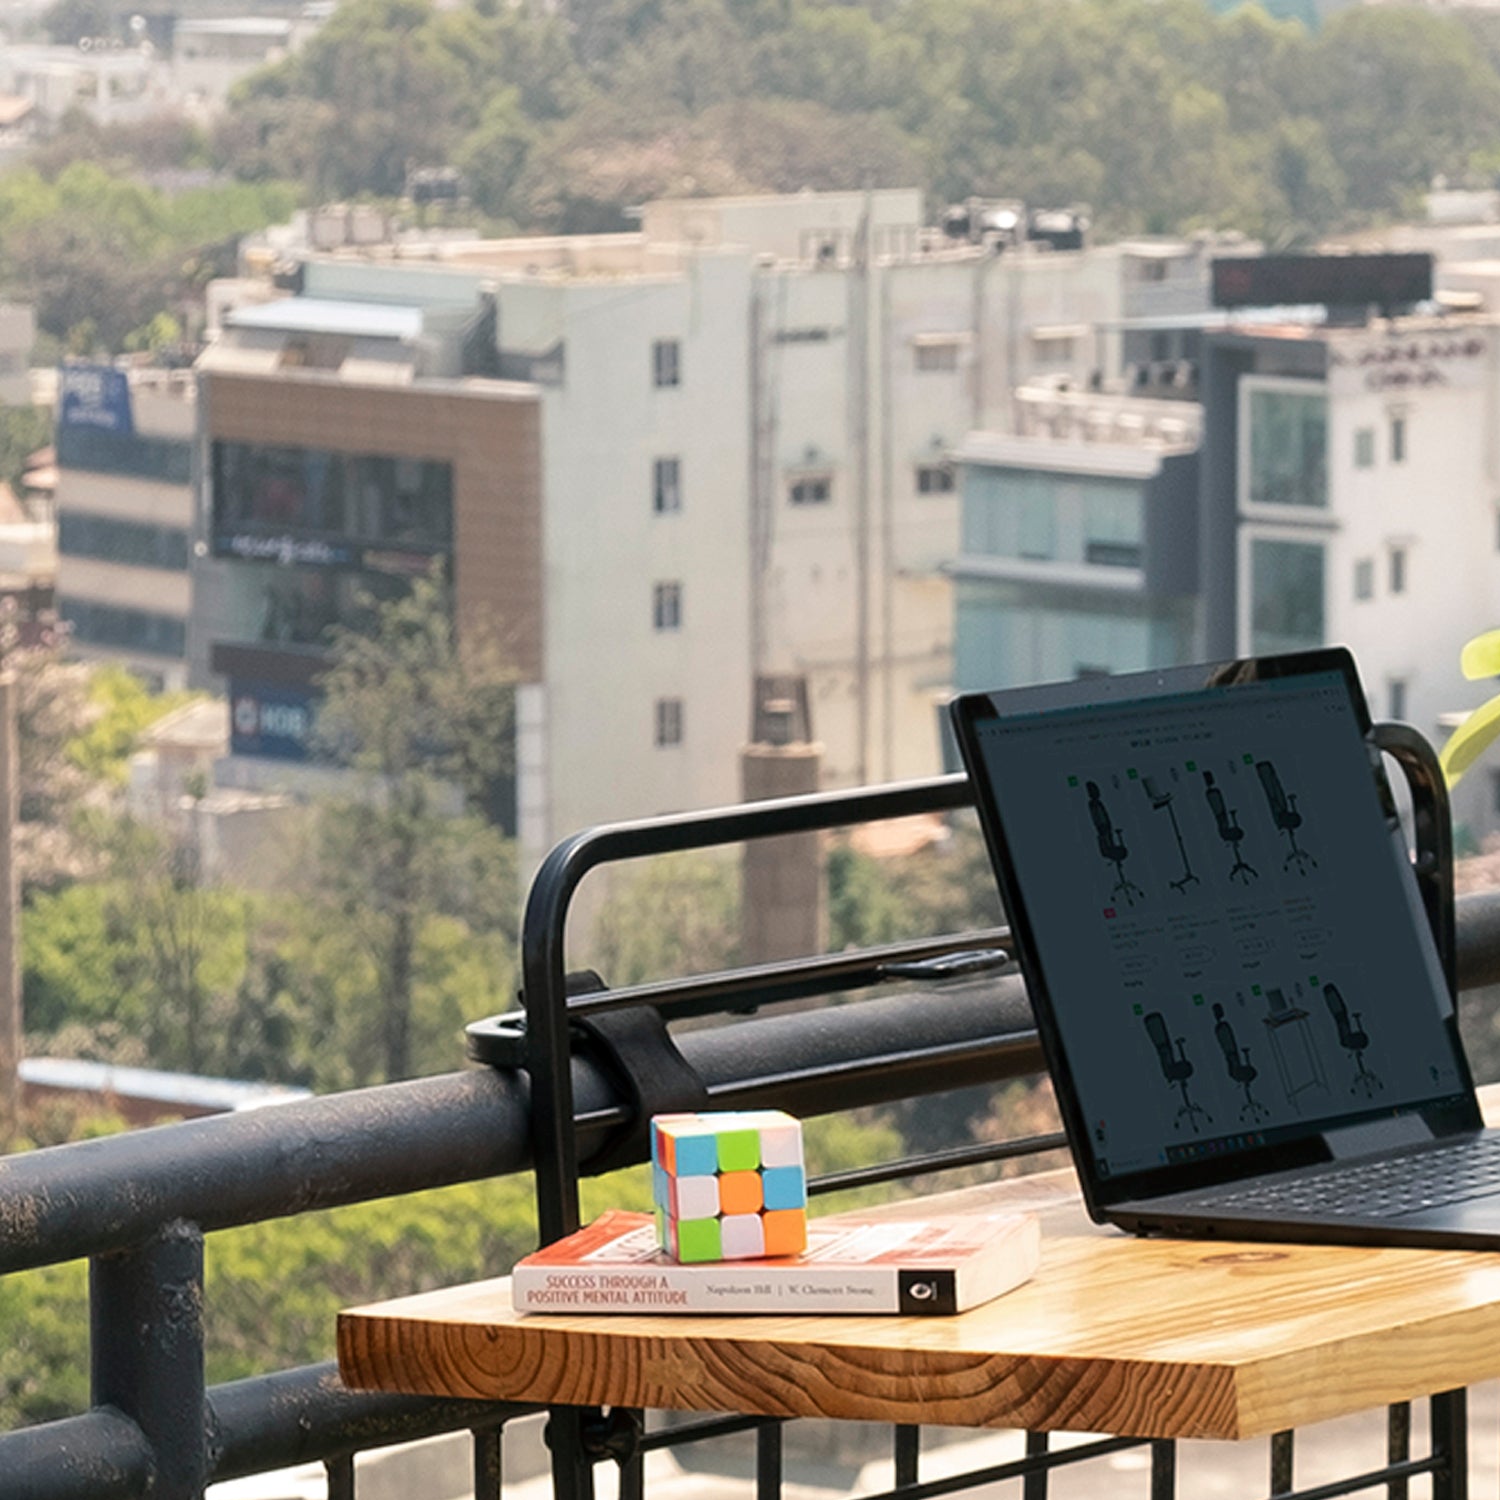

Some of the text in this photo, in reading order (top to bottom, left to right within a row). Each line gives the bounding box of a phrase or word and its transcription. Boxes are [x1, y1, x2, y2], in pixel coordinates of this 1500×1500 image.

[546, 1274, 668, 1288] SUCCESS THROUGH A
[527, 1290, 687, 1304] POSITIVE MENTAL ATTITUDE
